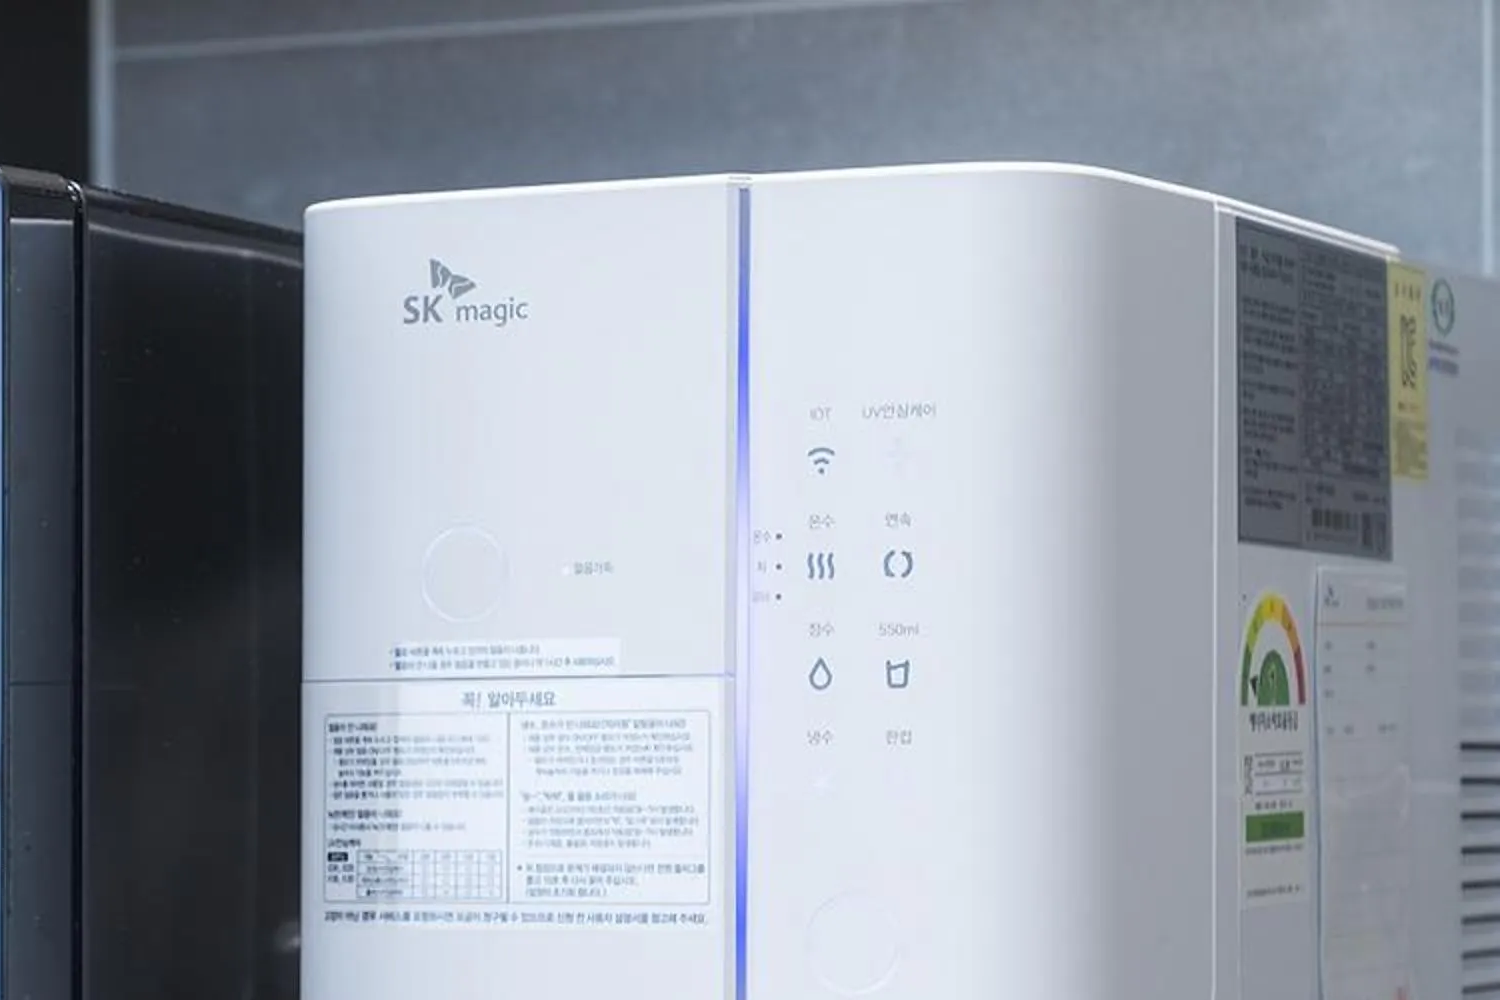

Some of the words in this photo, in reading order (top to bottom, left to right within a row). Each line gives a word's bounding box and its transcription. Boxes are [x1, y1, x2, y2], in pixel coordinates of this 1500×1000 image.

[403, 294, 444, 325] SK
[455, 296, 529, 328] magic
[878, 621, 920, 638] 550ml
[487, 690, 557, 709] 알아두세요
